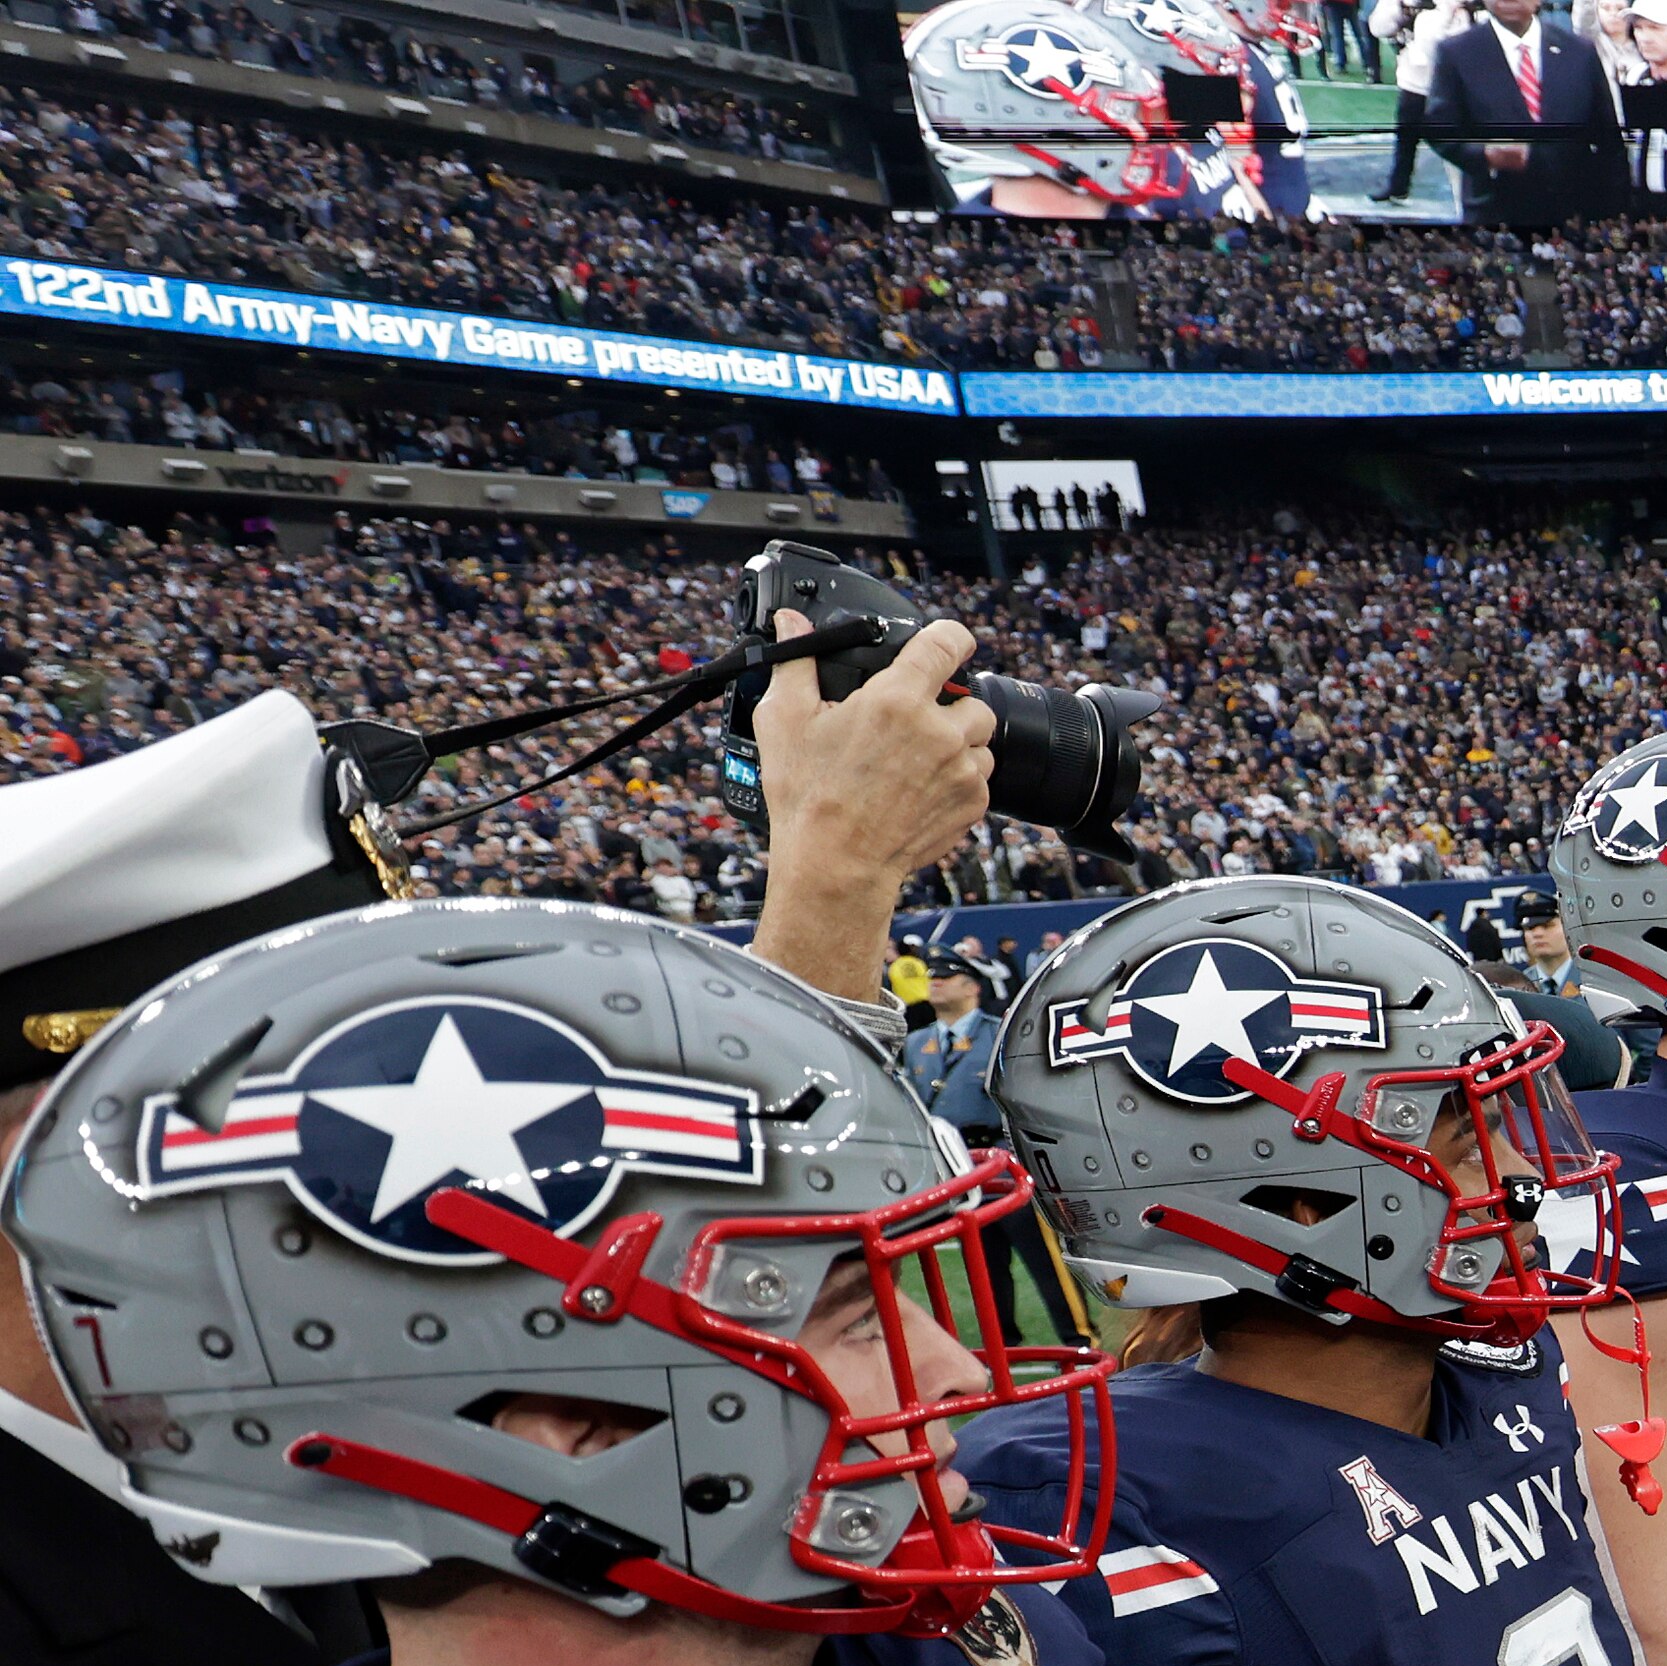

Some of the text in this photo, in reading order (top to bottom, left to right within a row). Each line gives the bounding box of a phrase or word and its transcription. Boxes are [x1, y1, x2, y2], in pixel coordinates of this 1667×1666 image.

[7, 259, 955, 407] 122nd Army-Navy Game presented by USAA
[1482, 371, 1643, 407] Welcome
[1394, 1465, 1579, 1617] NAVY
